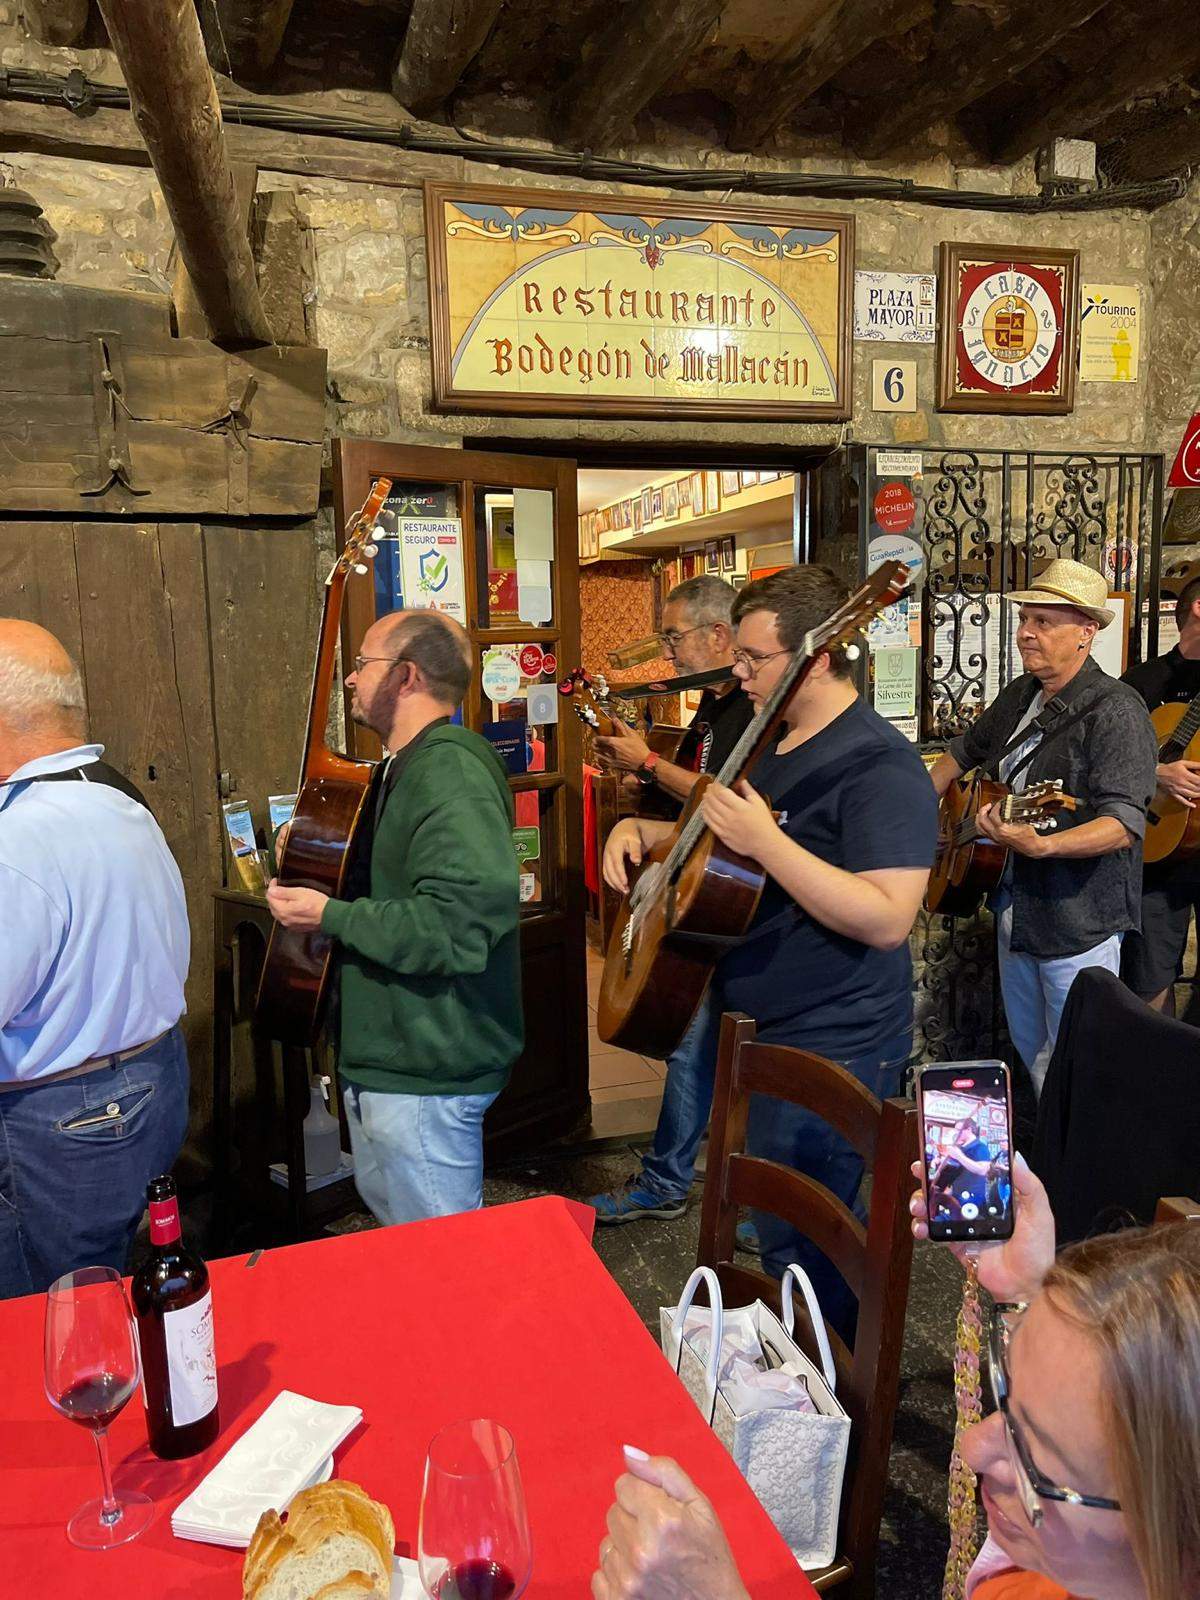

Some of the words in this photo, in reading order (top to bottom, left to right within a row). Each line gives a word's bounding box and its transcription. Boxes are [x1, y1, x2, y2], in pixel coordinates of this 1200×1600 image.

[523, 279, 776, 327] Restaurante
[869, 289, 914, 307] PLAZA
[866, 307, 915, 328] MAYOR
[1095, 305, 1136, 316] TOURING
[1111, 316, 1137, 329] 2004
[485, 332, 632, 384] Bodegón
[640, 338, 671, 379] de
[676, 345, 808, 388] Mallacán
[883, 367, 905, 403] 6
[875, 502, 915, 514] MICHELIN
[403, 523, 457, 533] RESTAURANTE
[404, 535, 436, 544] SEGURO
[877, 690, 913, 700] Silvestre
[191, 1317, 210, 1338] SOM
